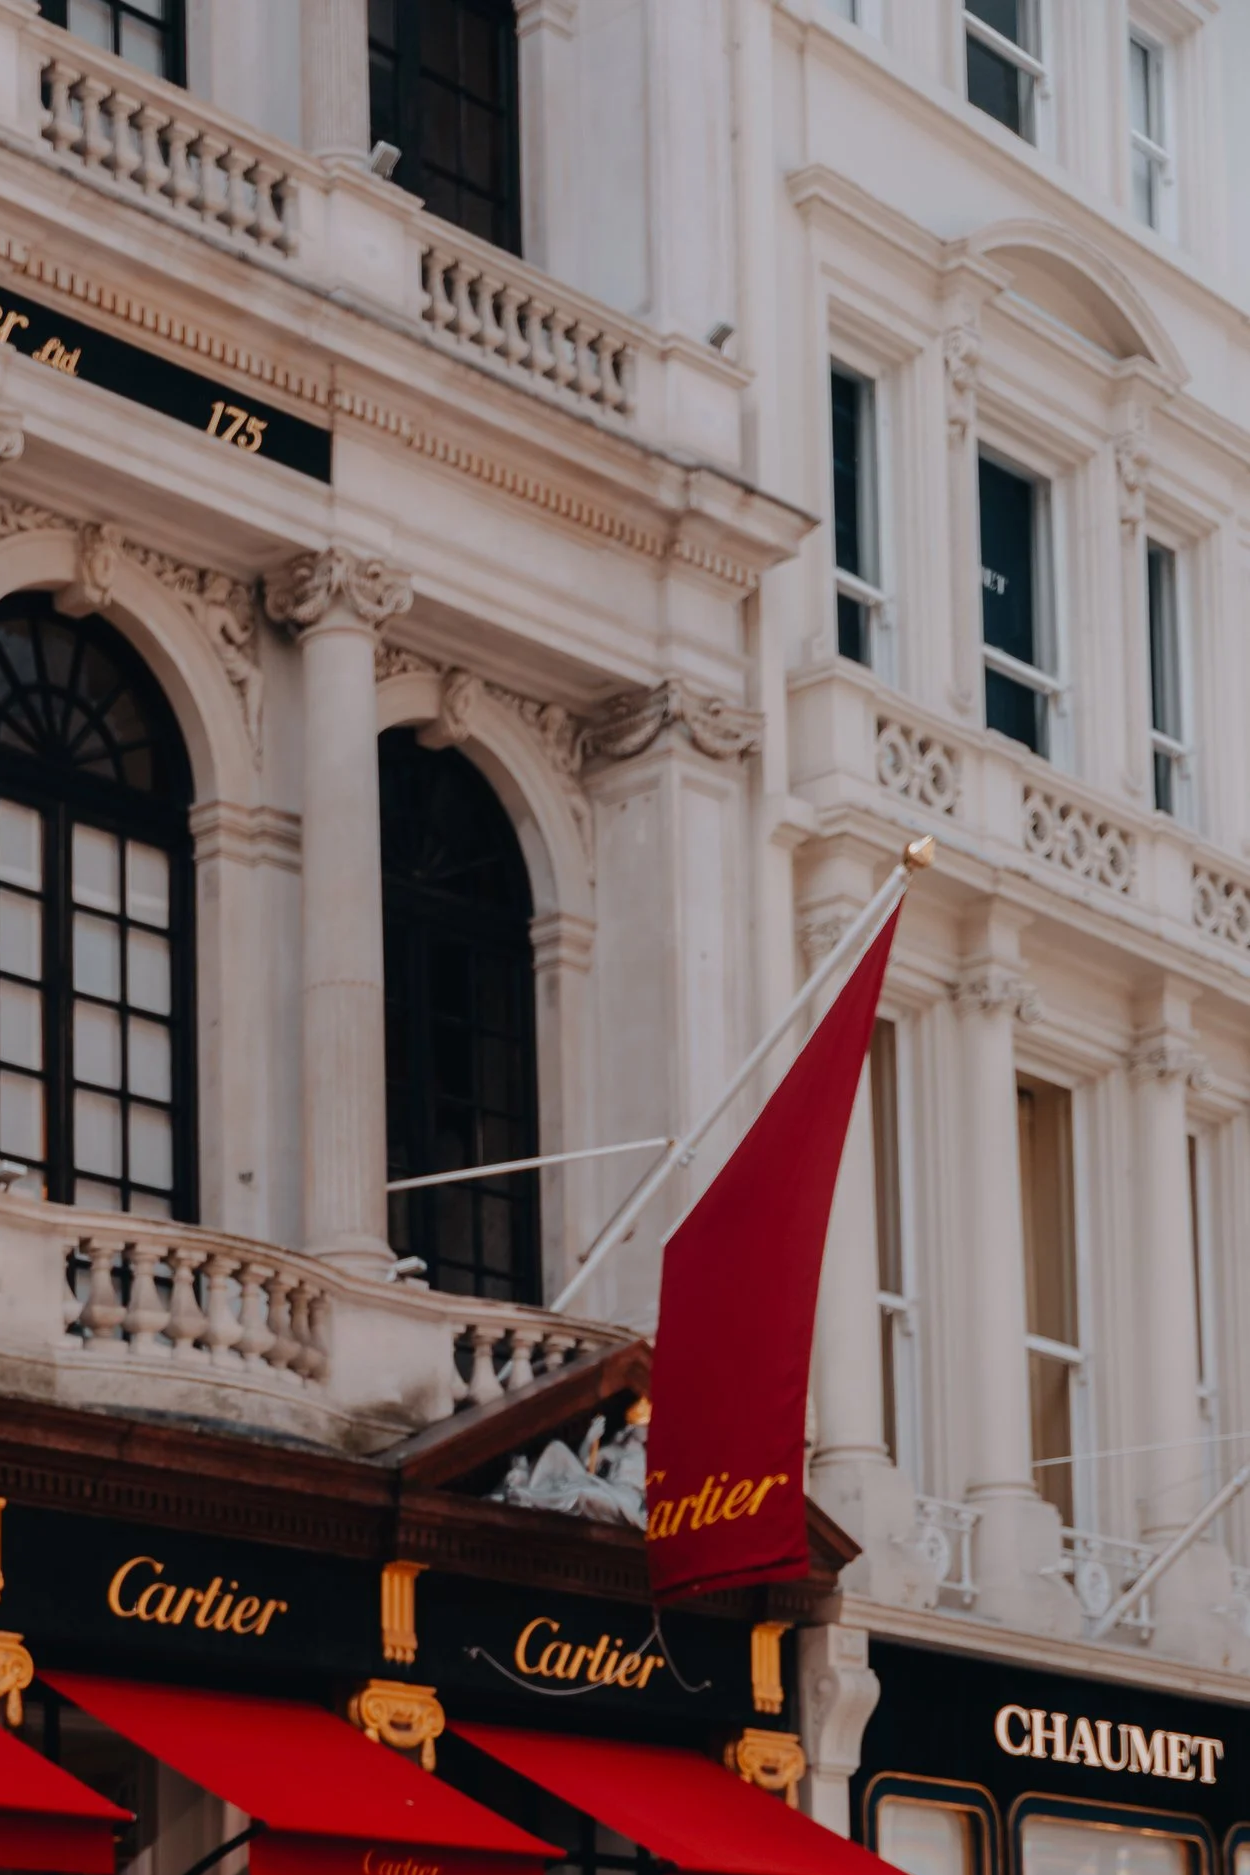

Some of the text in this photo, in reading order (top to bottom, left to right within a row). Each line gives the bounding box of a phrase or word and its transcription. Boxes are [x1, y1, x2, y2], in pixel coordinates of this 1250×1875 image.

[206, 401, 269, 453] 175
[645, 1469, 790, 1541] artier
[107, 1556, 288, 1636] Cartier
[514, 1616, 665, 1690] Cartier
[994, 1704, 1224, 1785] CHAUMET
